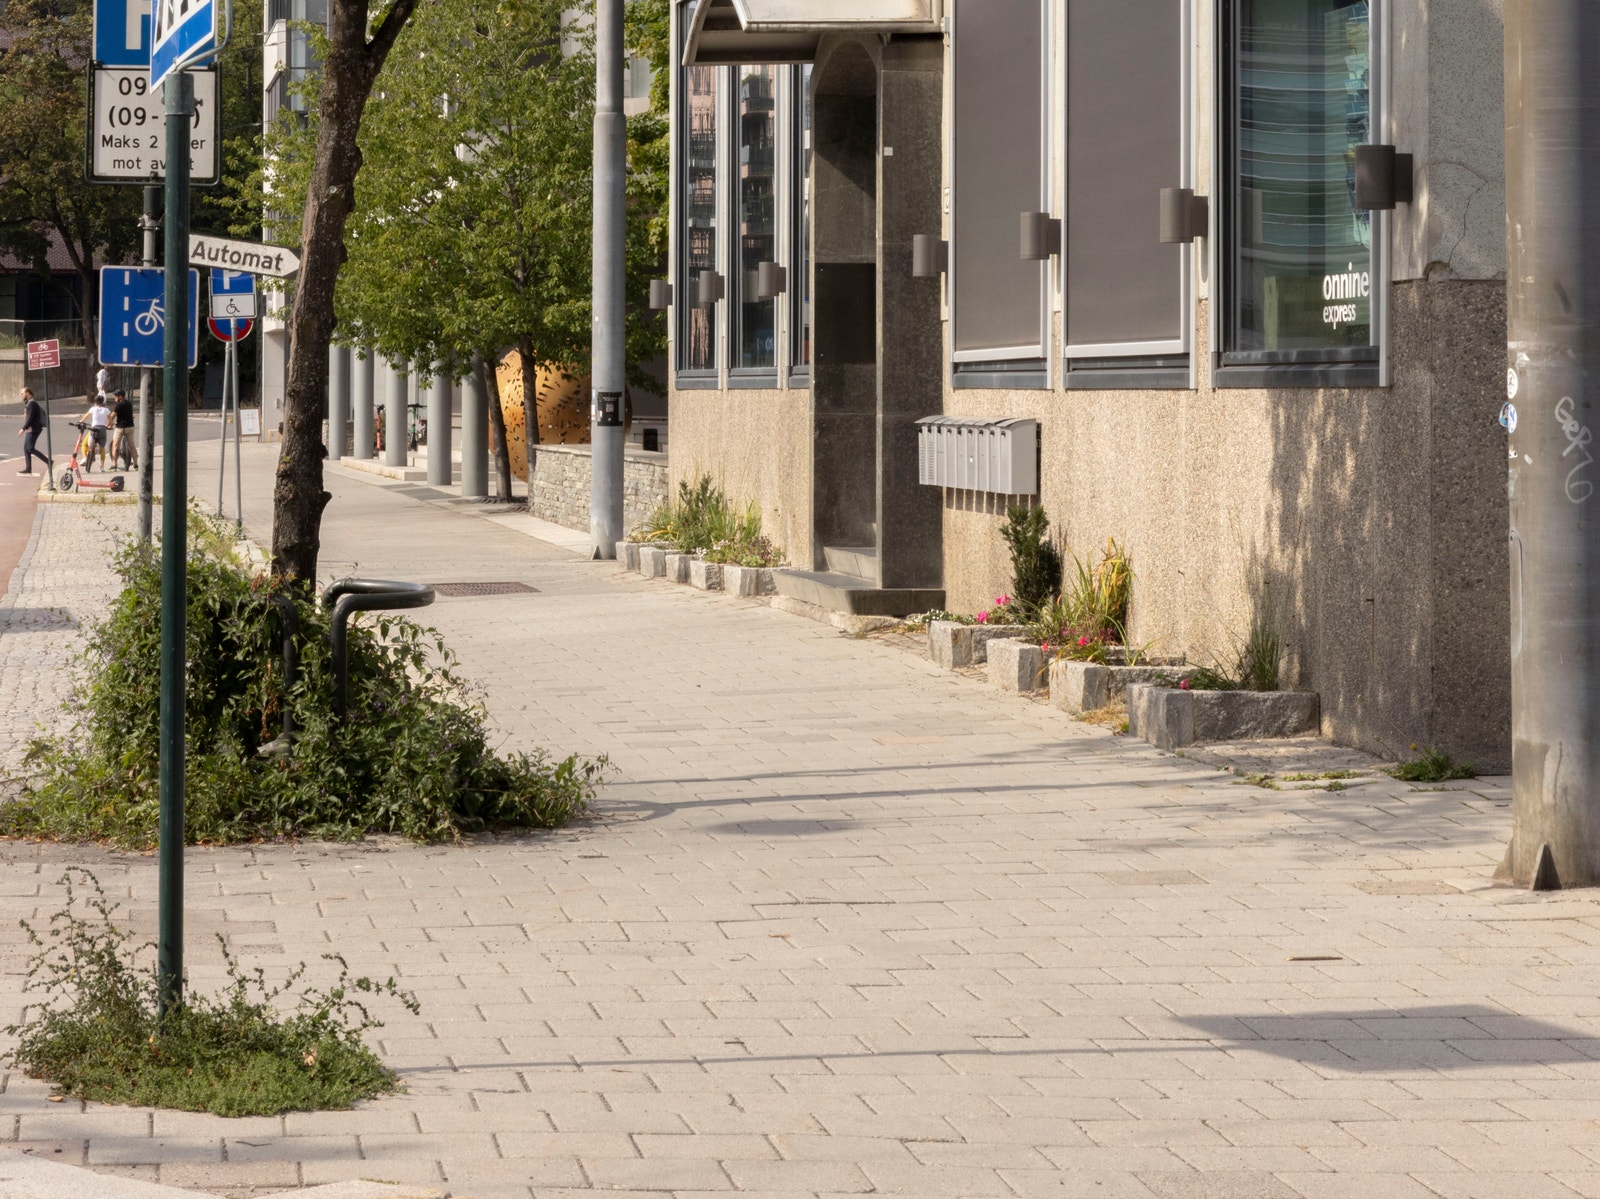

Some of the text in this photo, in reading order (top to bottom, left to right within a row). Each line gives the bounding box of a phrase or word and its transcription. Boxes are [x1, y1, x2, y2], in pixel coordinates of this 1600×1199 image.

[102, 135, 158, 149] Maks 2
[113, 157, 141, 169] mot
[191, 241, 283, 271] Automat
[1323, 261, 1370, 300] onnine
[1323, 304, 1356, 330] express
